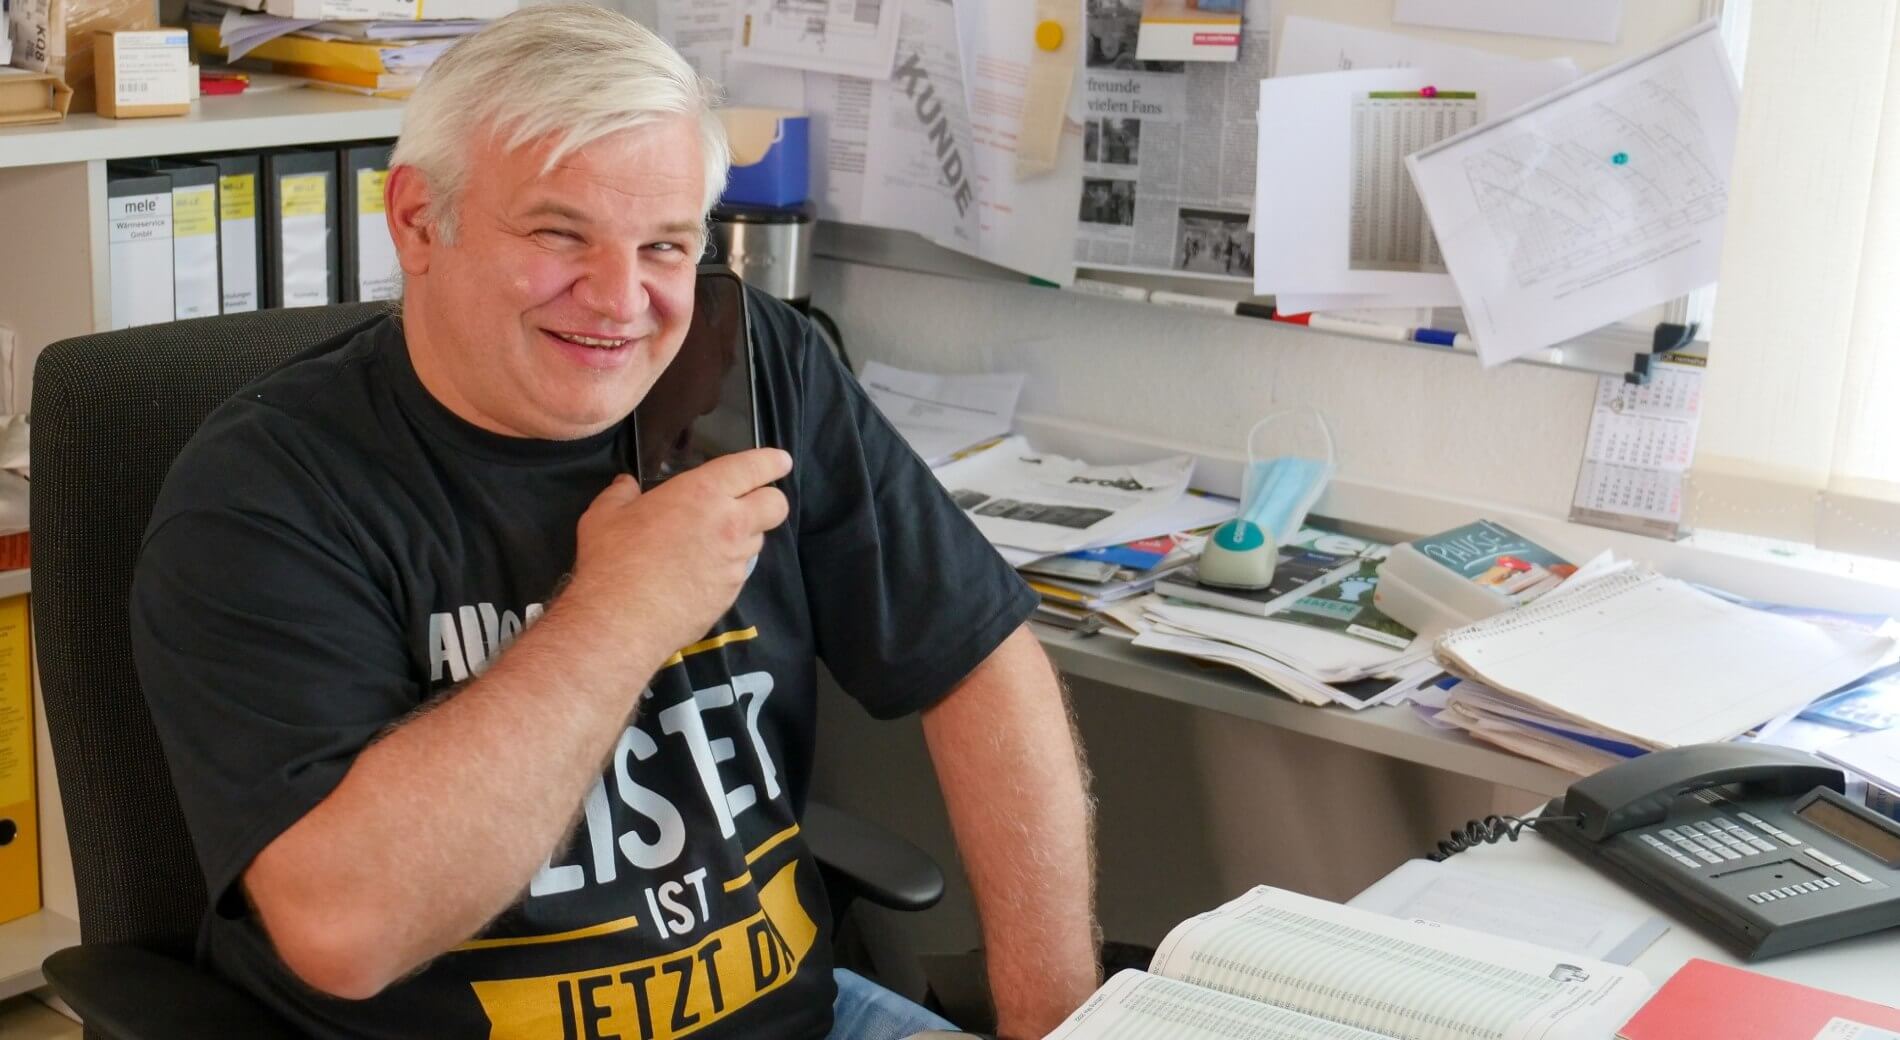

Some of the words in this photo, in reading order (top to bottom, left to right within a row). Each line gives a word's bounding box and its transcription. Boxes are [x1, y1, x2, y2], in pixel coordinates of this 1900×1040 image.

[896, 53, 973, 219] KUNDE
[1087, 98, 1128, 112] vielen
[1131, 99, 1163, 113] Fans
[125, 199, 156, 213] mele
[644, 867, 709, 939] IST
[557, 938, 725, 1040] JETZT
